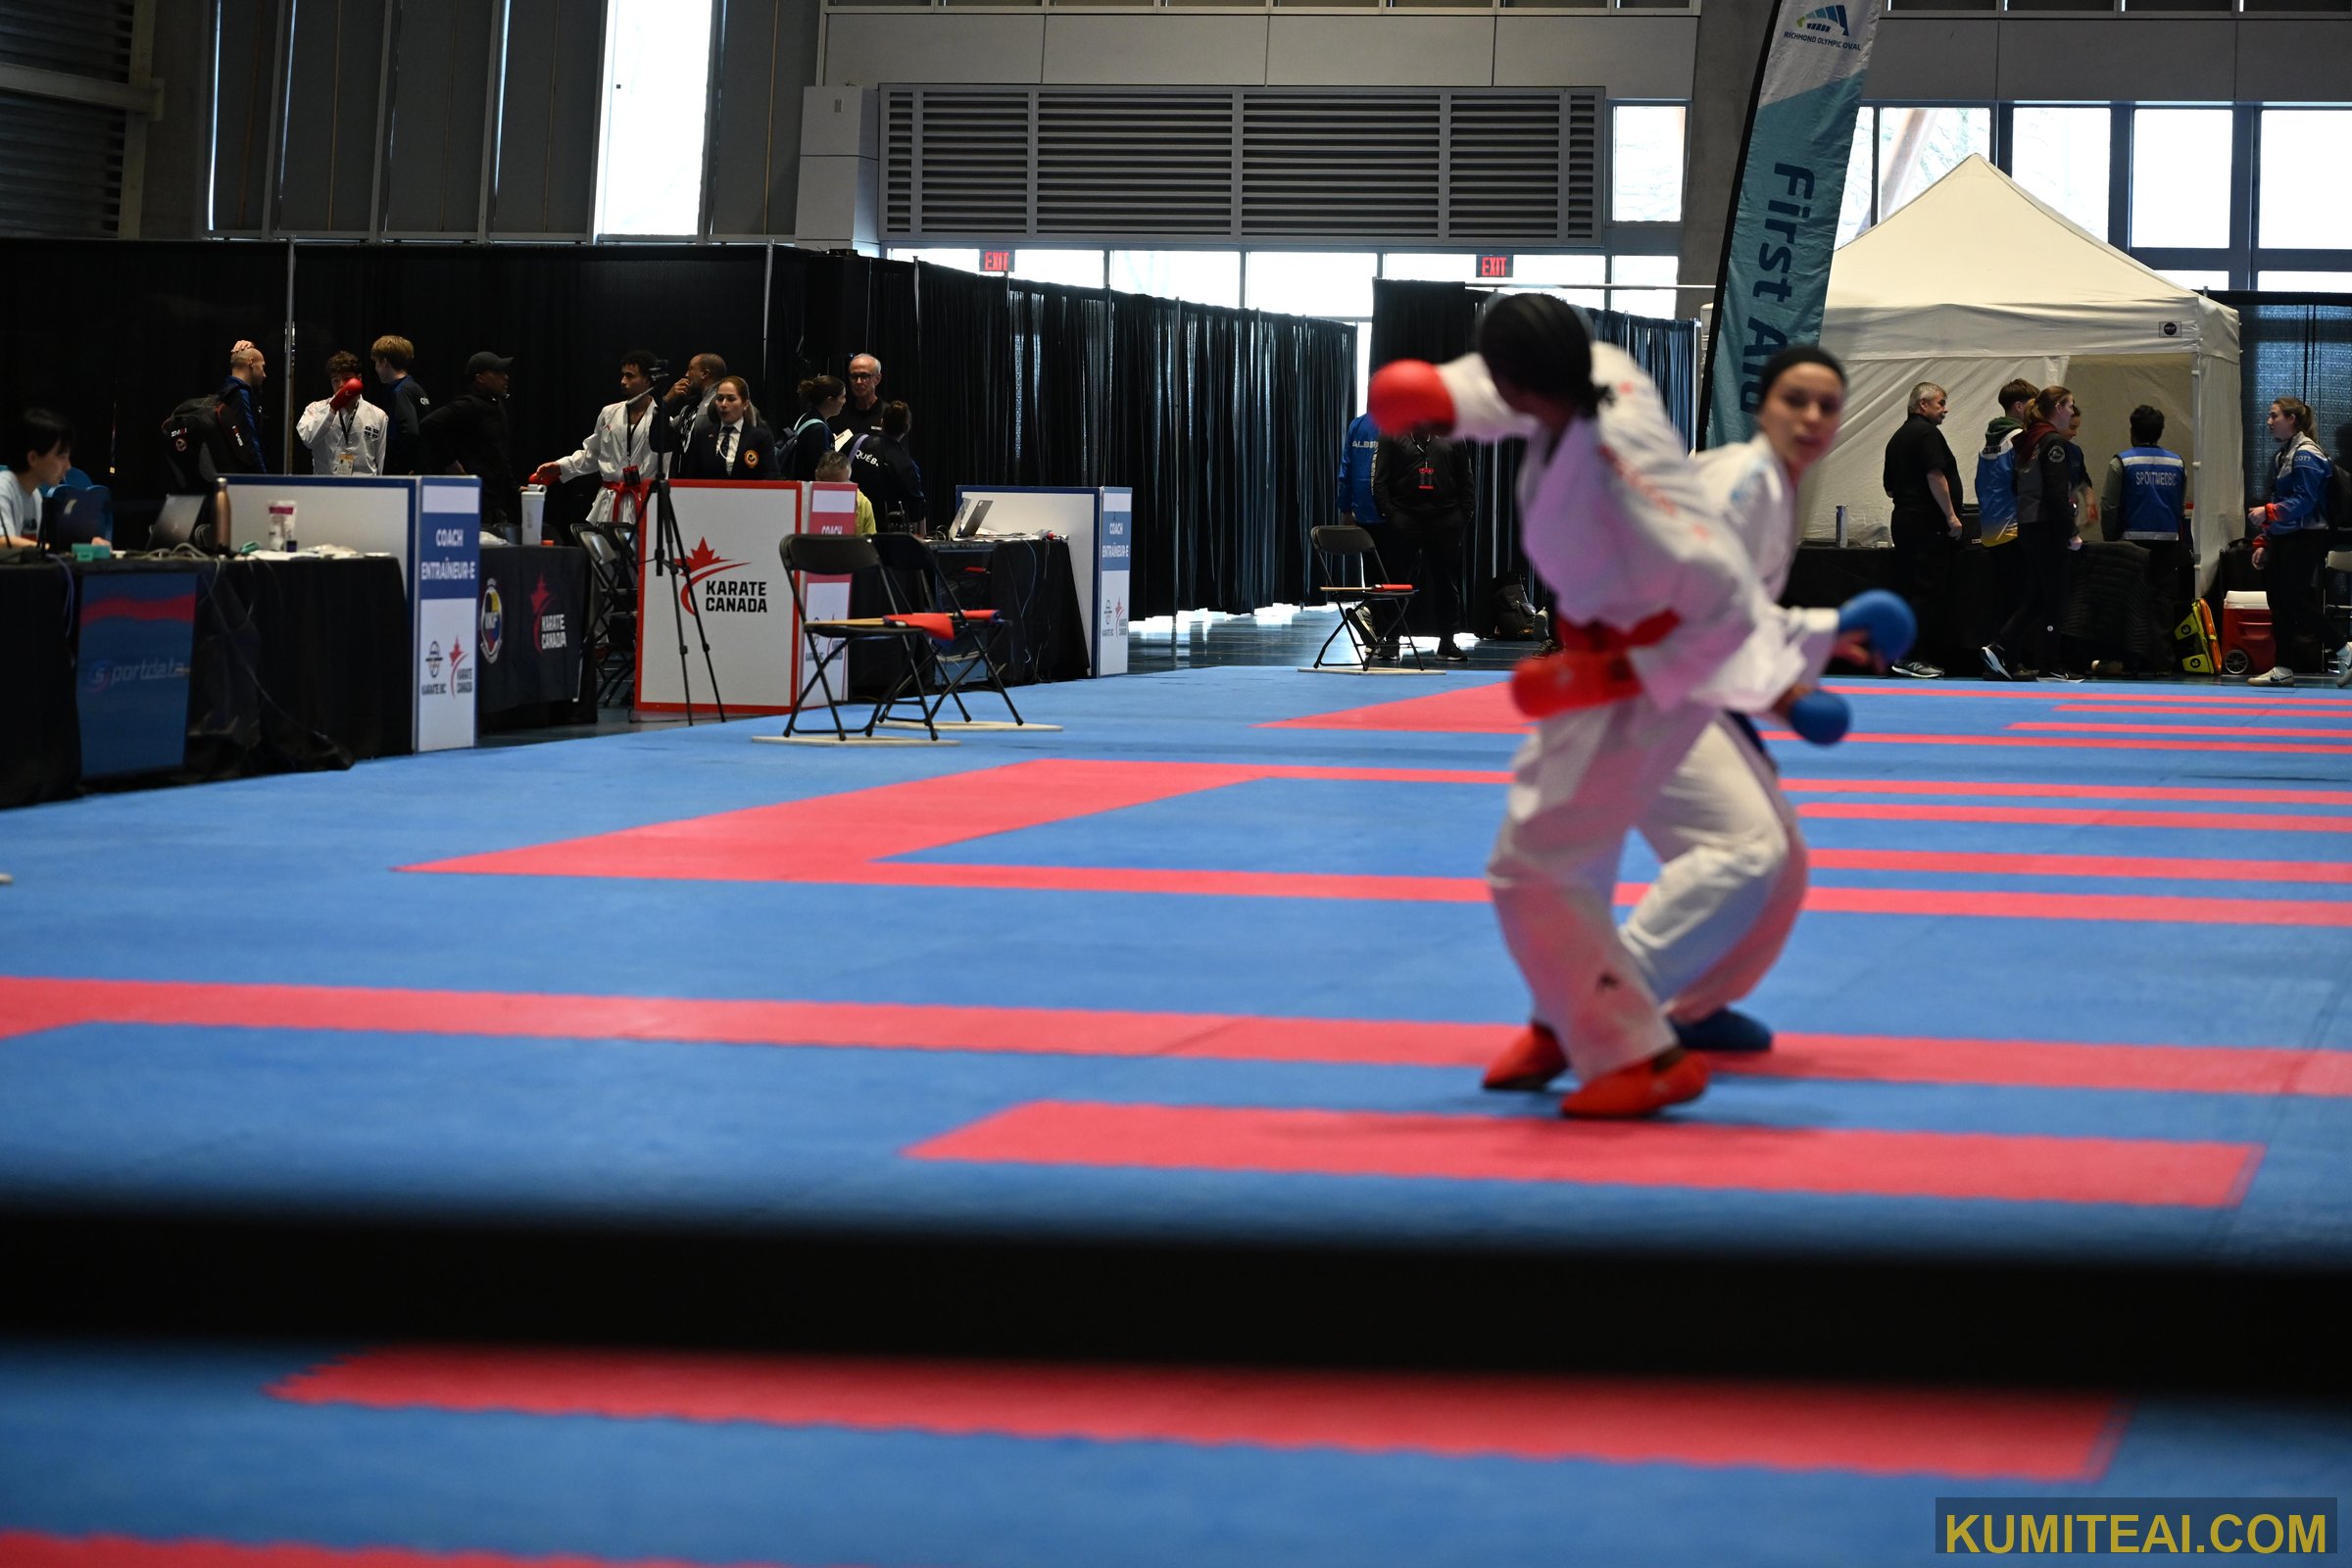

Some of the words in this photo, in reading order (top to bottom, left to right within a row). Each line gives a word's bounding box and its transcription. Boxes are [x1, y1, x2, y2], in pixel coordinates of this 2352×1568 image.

[1784, 30, 1817, 43] RICHMOND
[1817, 37, 1842, 48] OLYMPIC
[1842, 42, 1861, 51] OVAL
[1752, 163, 1815, 303] First
[985, 251, 1009, 271] EXIT
[1482, 257, 1506, 276] EXIT
[435, 529, 464, 547] COACH
[706, 580, 766, 596] KARATE
[706, 597, 767, 612] CANADA
[542, 614, 564, 631] KARATE
[542, 632, 566, 649] CANADA
